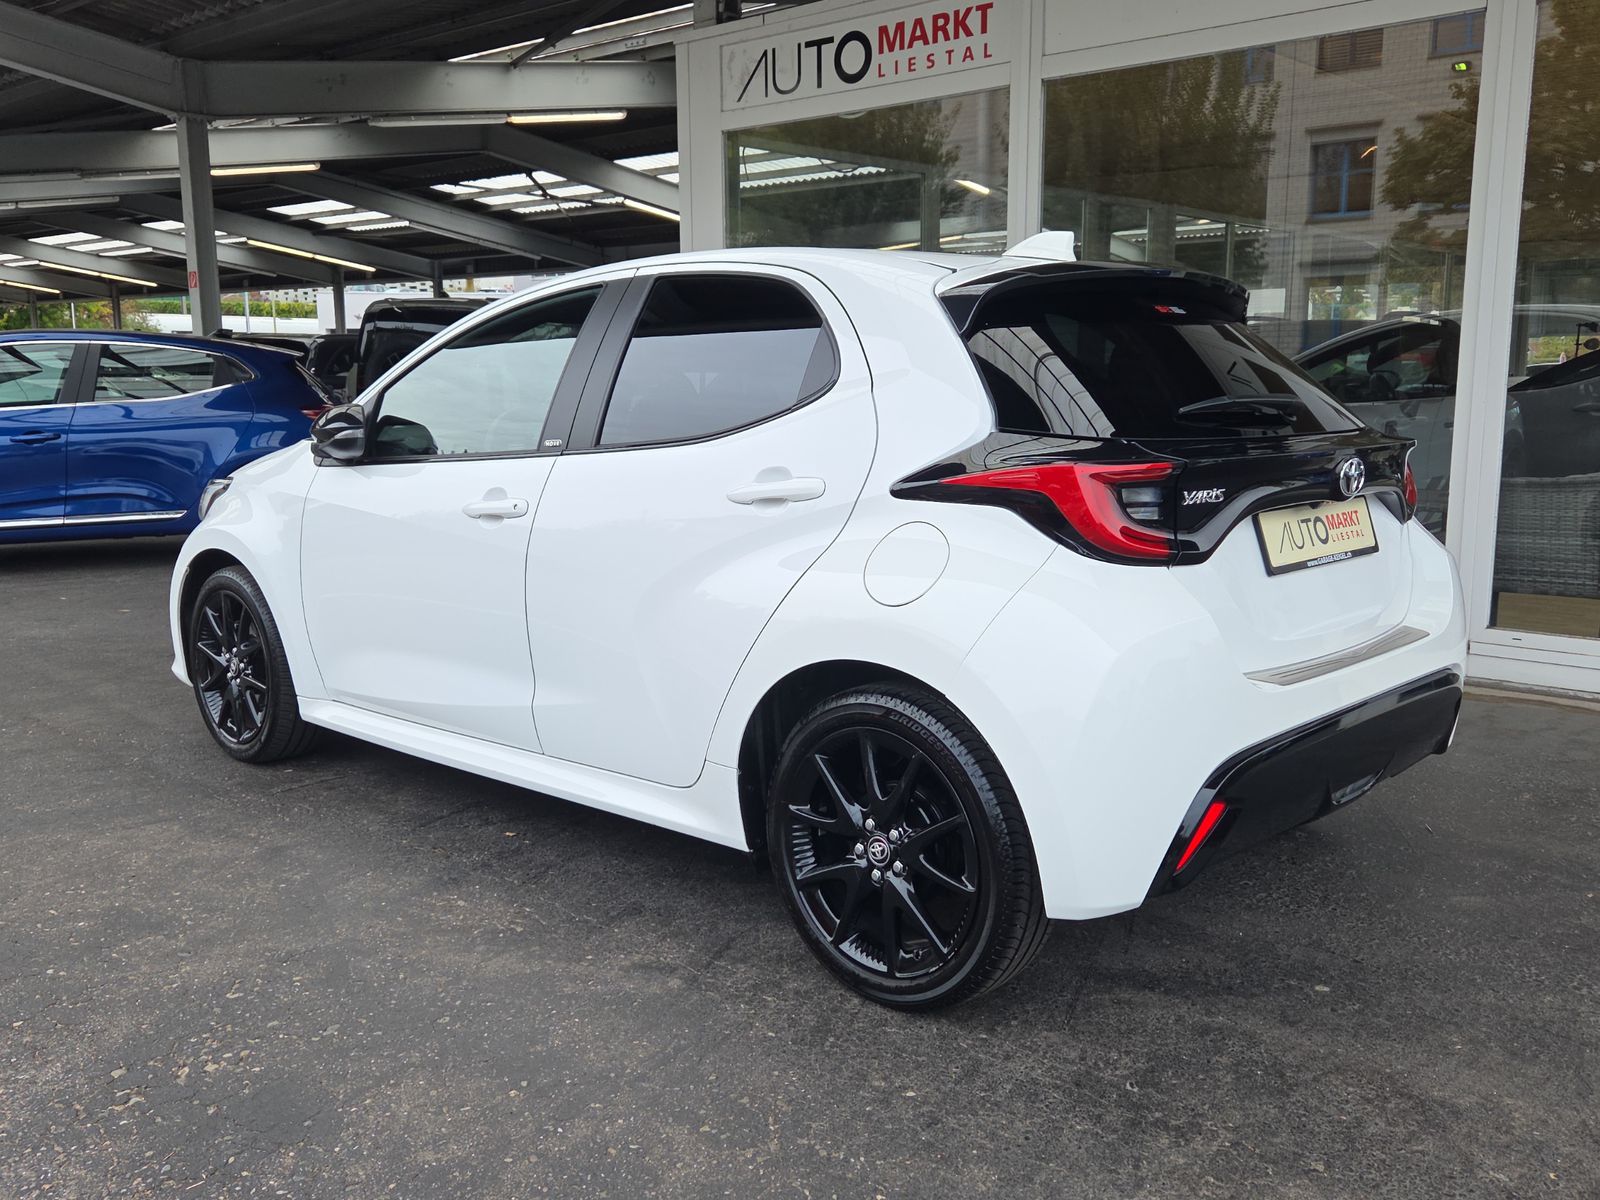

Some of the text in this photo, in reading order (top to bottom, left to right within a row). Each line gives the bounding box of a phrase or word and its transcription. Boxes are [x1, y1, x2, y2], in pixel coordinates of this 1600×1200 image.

[736, 2, 994, 103] AUTO MARKT
[877, 42, 993, 79] LIESTAL
[1182, 488, 1226, 506] YARIS
[1279, 510, 1361, 554] AUTO MARKT
[1331, 528, 1365, 543] LIESTAL
[888, 710, 964, 782] BRIDGESTO
